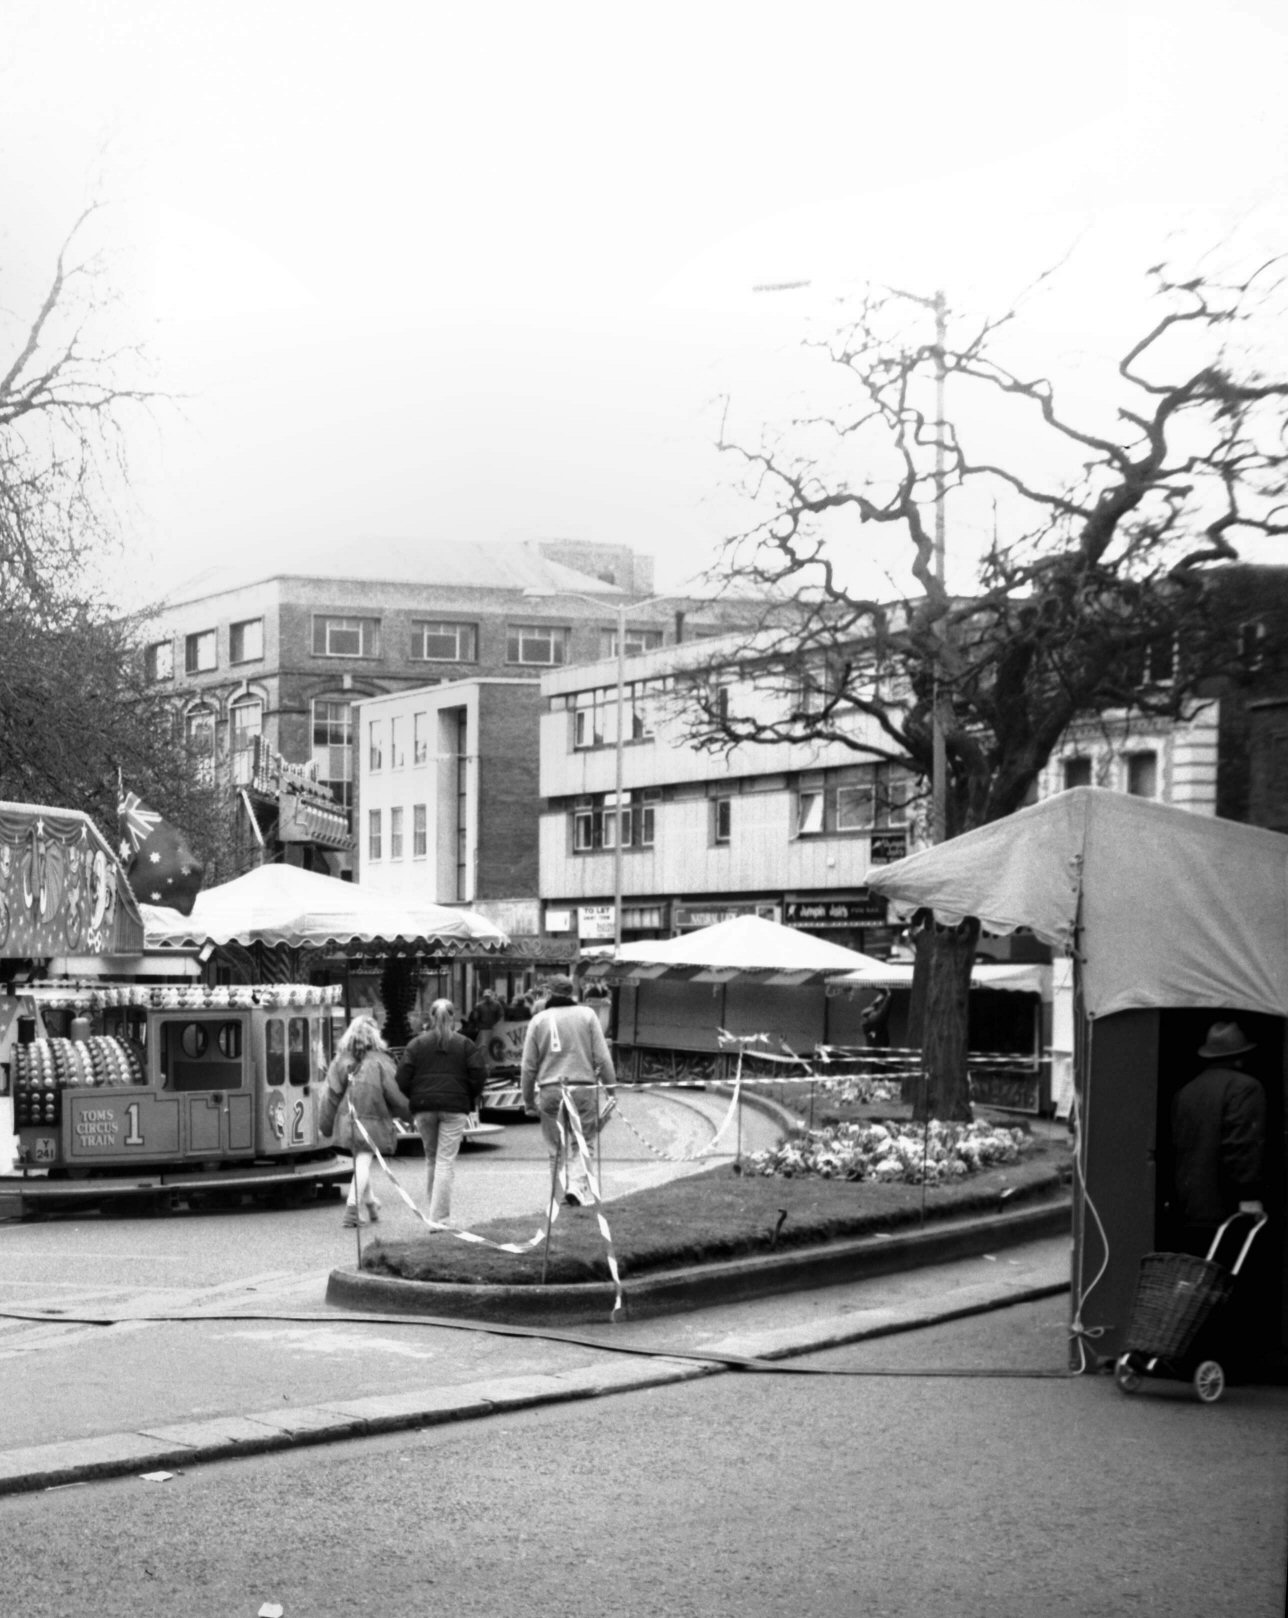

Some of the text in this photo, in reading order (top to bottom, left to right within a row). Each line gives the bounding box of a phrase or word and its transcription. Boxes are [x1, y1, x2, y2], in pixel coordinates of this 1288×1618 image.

[584, 906, 610, 914] TO LET
[80, 1108, 114, 1121] TOMS
[76, 1121, 119, 1135] CIRCUS
[124, 1102, 145, 1146] 1
[291, 1099, 305, 1145] 2
[42, 1139, 50, 1148] Y
[79, 1134, 115, 1147] TRAIN
